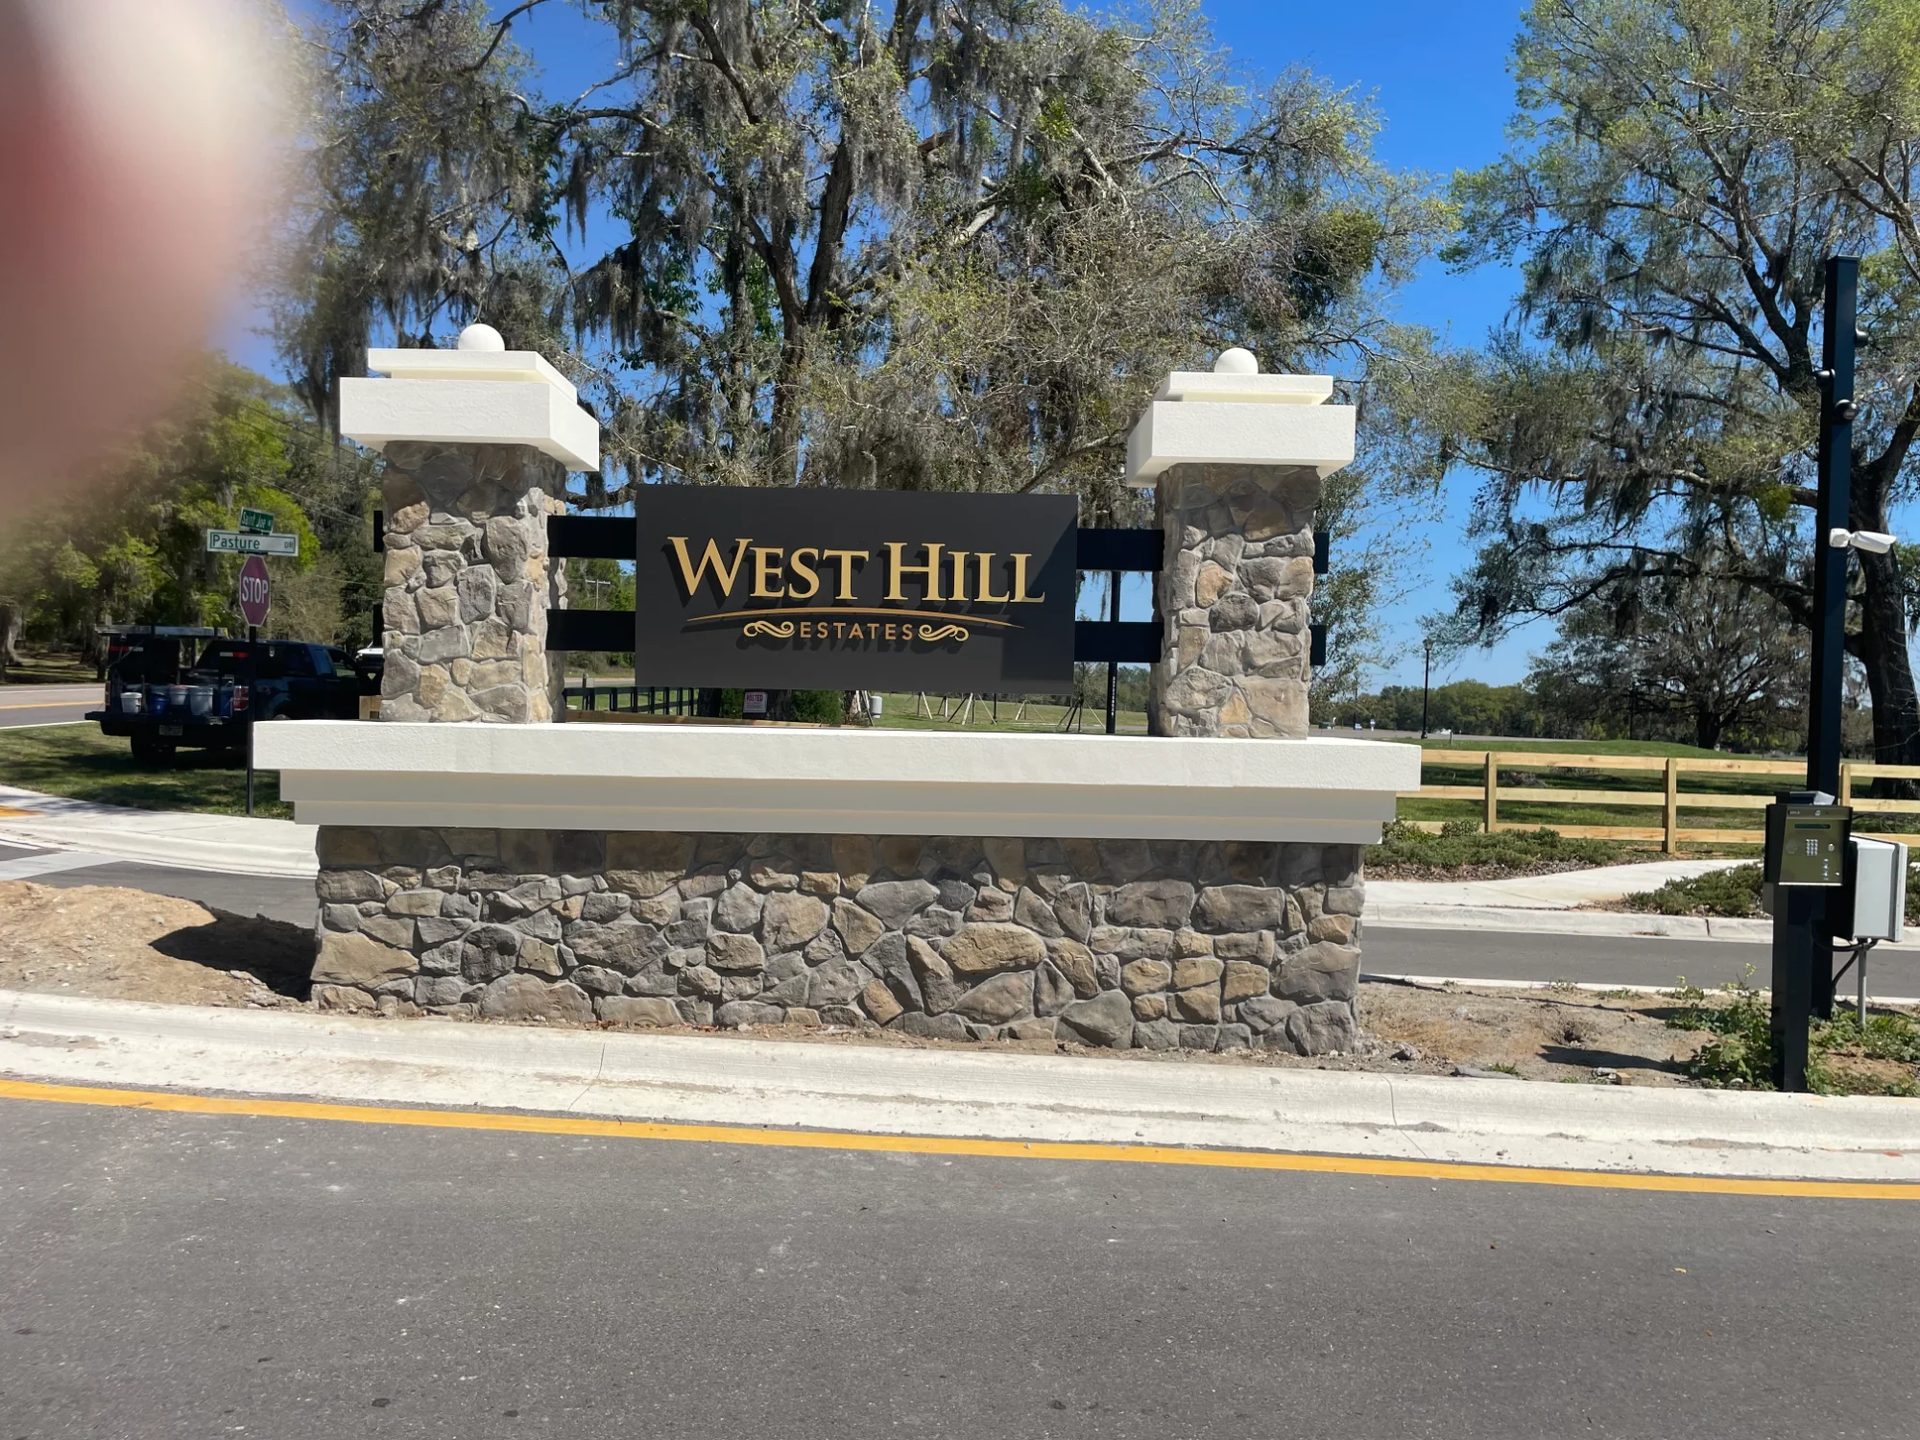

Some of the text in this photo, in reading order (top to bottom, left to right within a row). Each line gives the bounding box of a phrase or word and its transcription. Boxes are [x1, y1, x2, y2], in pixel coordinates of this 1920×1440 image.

[212, 534, 260, 549] Pasture
[667, 536, 1045, 603] WEST HILL
[241, 576, 269, 604] STOP
[800, 621, 913, 641] ESTATES
